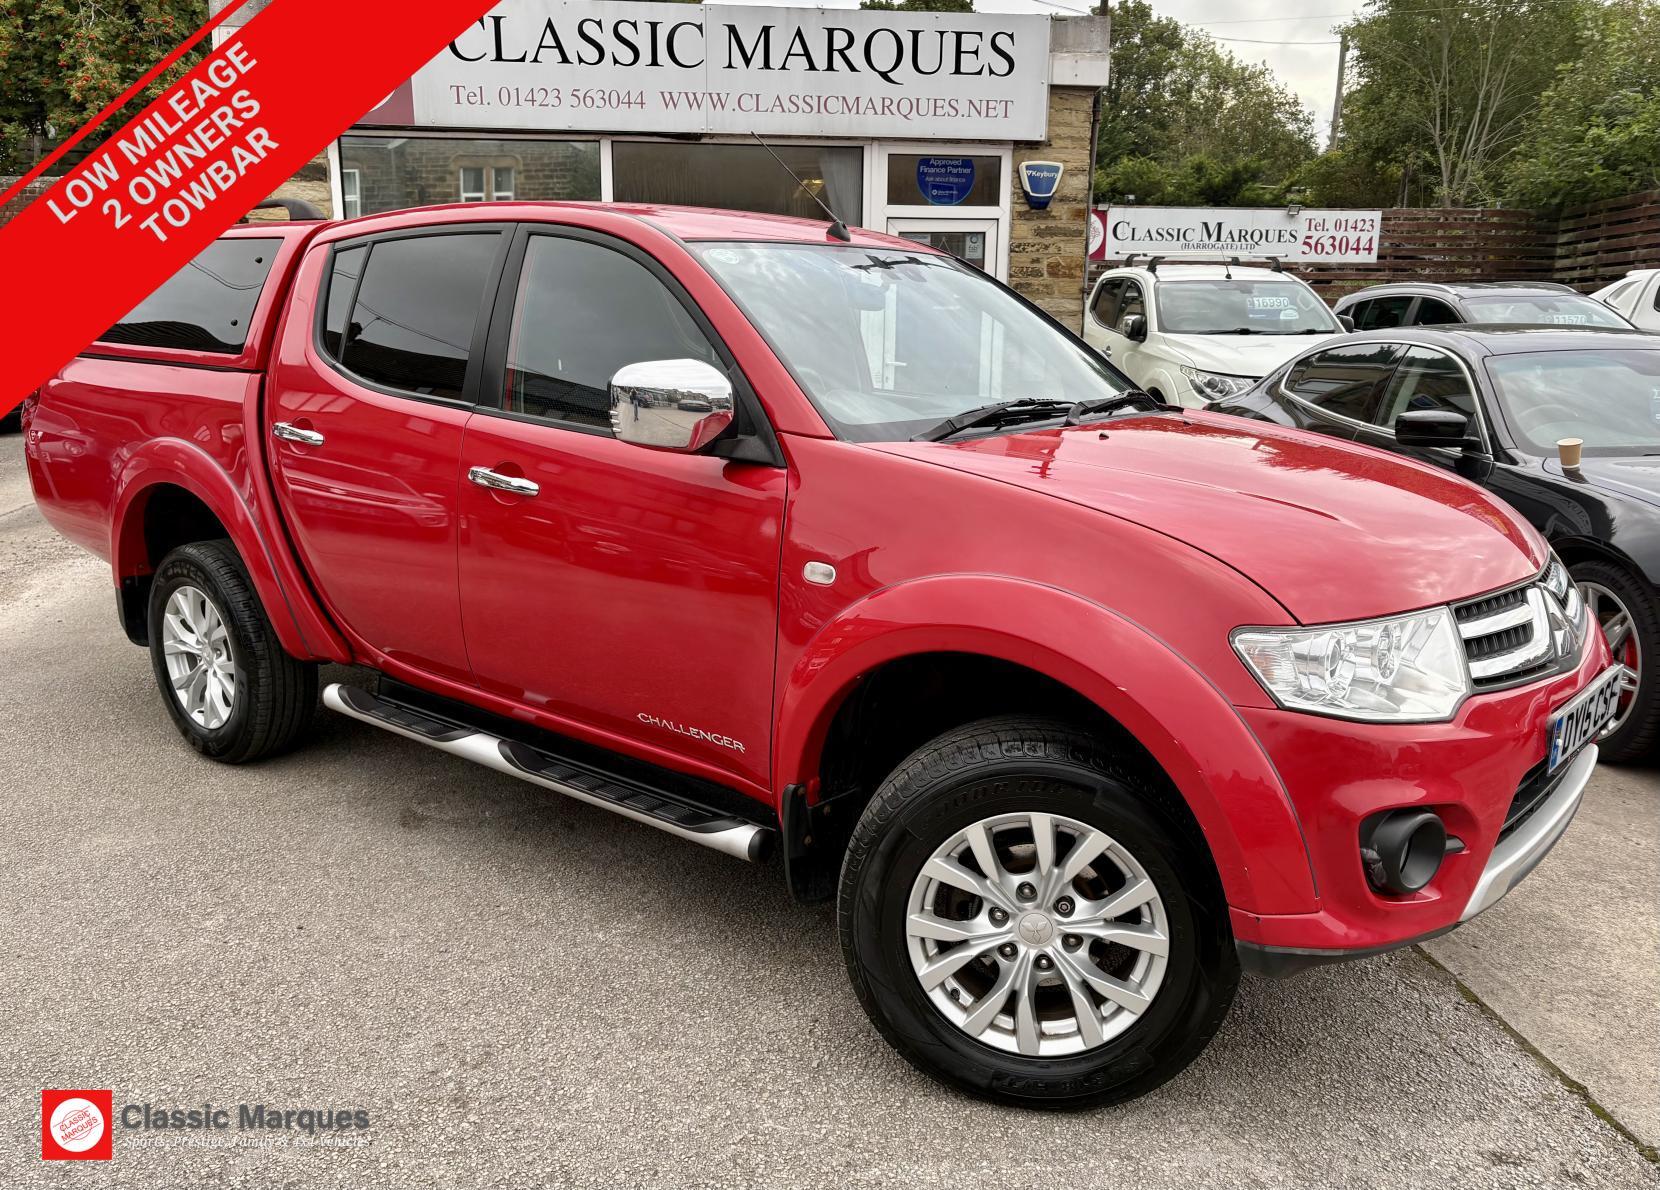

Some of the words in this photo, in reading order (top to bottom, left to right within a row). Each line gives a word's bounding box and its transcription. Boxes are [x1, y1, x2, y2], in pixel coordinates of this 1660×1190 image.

[722, 23, 1016, 86] MARQUES
[450, 85, 491, 107] Tel.
[498, 86, 562, 108] 01423
[570, 88, 646, 110] 563044
[659, 91, 1014, 121] WWW.CLASSICMARQUES.NET
[920, 166, 946, 174] Finance
[929, 158, 962, 167] Approved
[1112, 220, 1195, 242] CLASSIC
[1200, 221, 1298, 246] MARQUES
[1305, 218, 1329, 232] Tel.
[1334, 218, 1375, 232] 01423
[1181, 242, 1239, 251] (HARROGATE)
[1301, 235, 1374, 256] 563044
[637, 712, 746, 754] CHALLENGER
